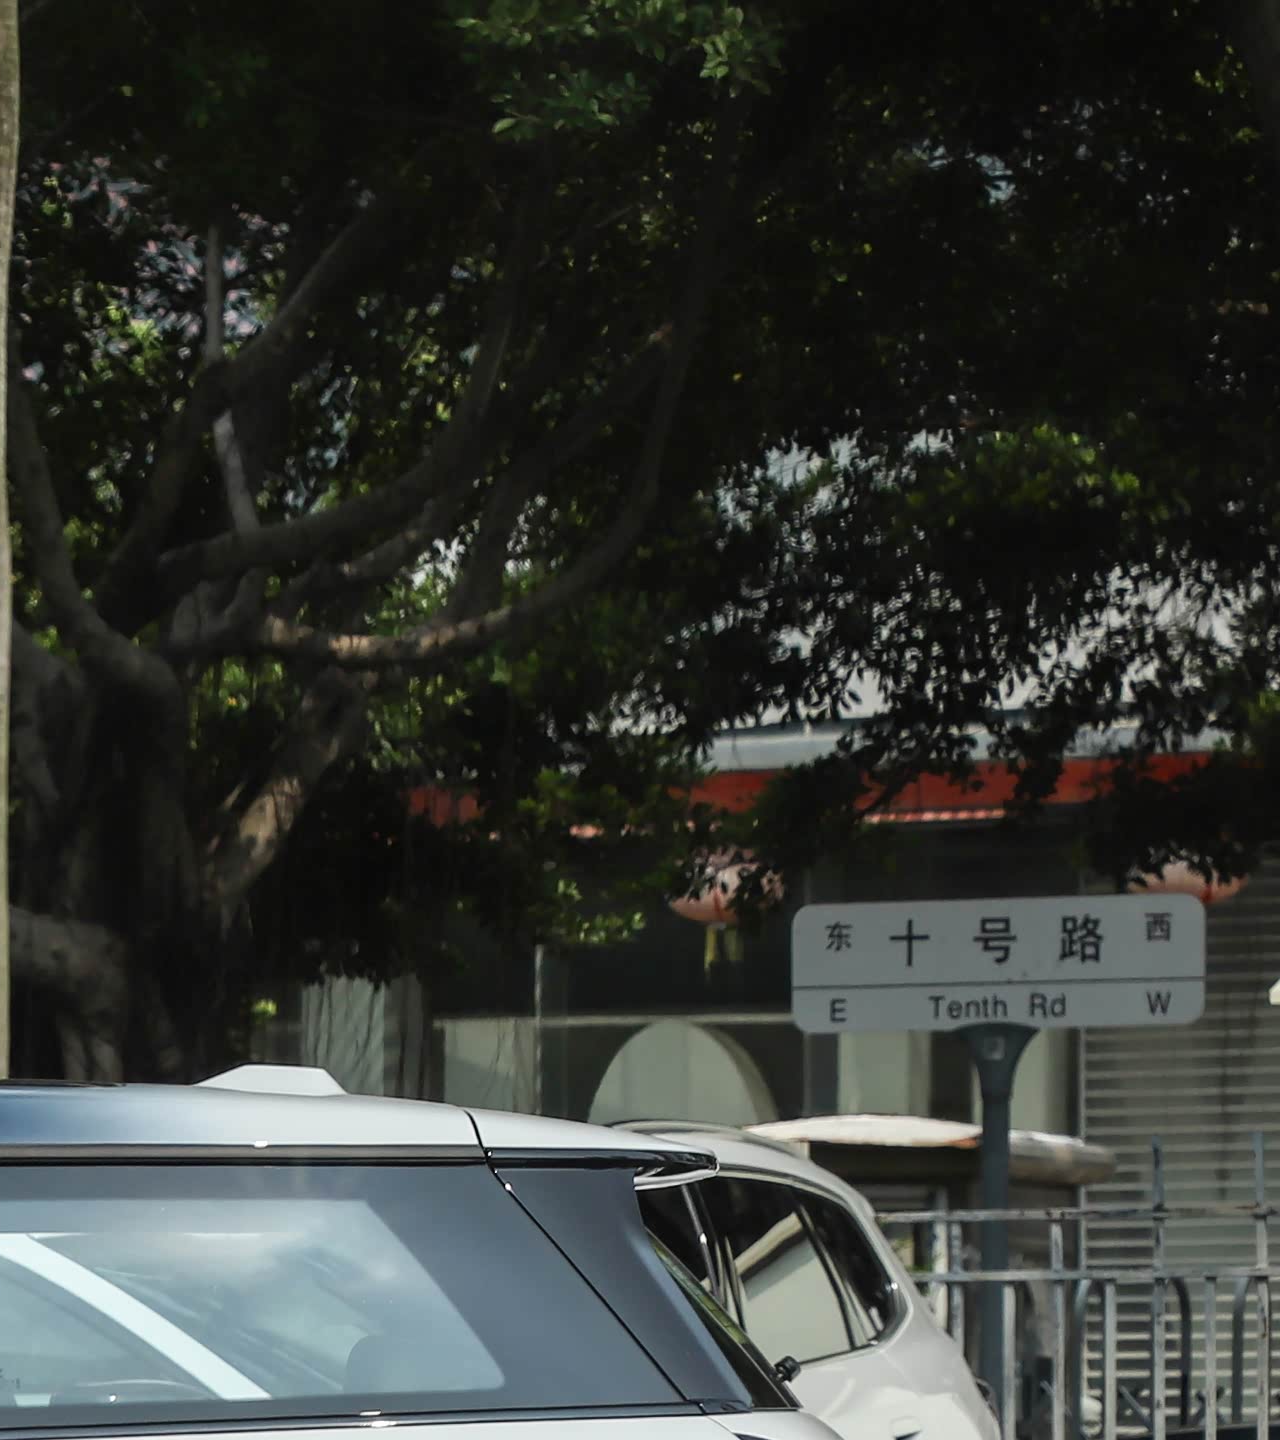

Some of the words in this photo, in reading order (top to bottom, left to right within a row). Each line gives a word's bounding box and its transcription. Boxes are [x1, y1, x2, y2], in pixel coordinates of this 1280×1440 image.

[825, 922, 852, 951] 东
[889, 914, 1104, 967] 十号路
[1145, 912, 1172, 942] 西
[829, 998, 848, 1023] E
[929, 995, 1009, 1020] Tenth
[1029, 992, 1067, 1019] Rd
[1146, 991, 1172, 1016] W
